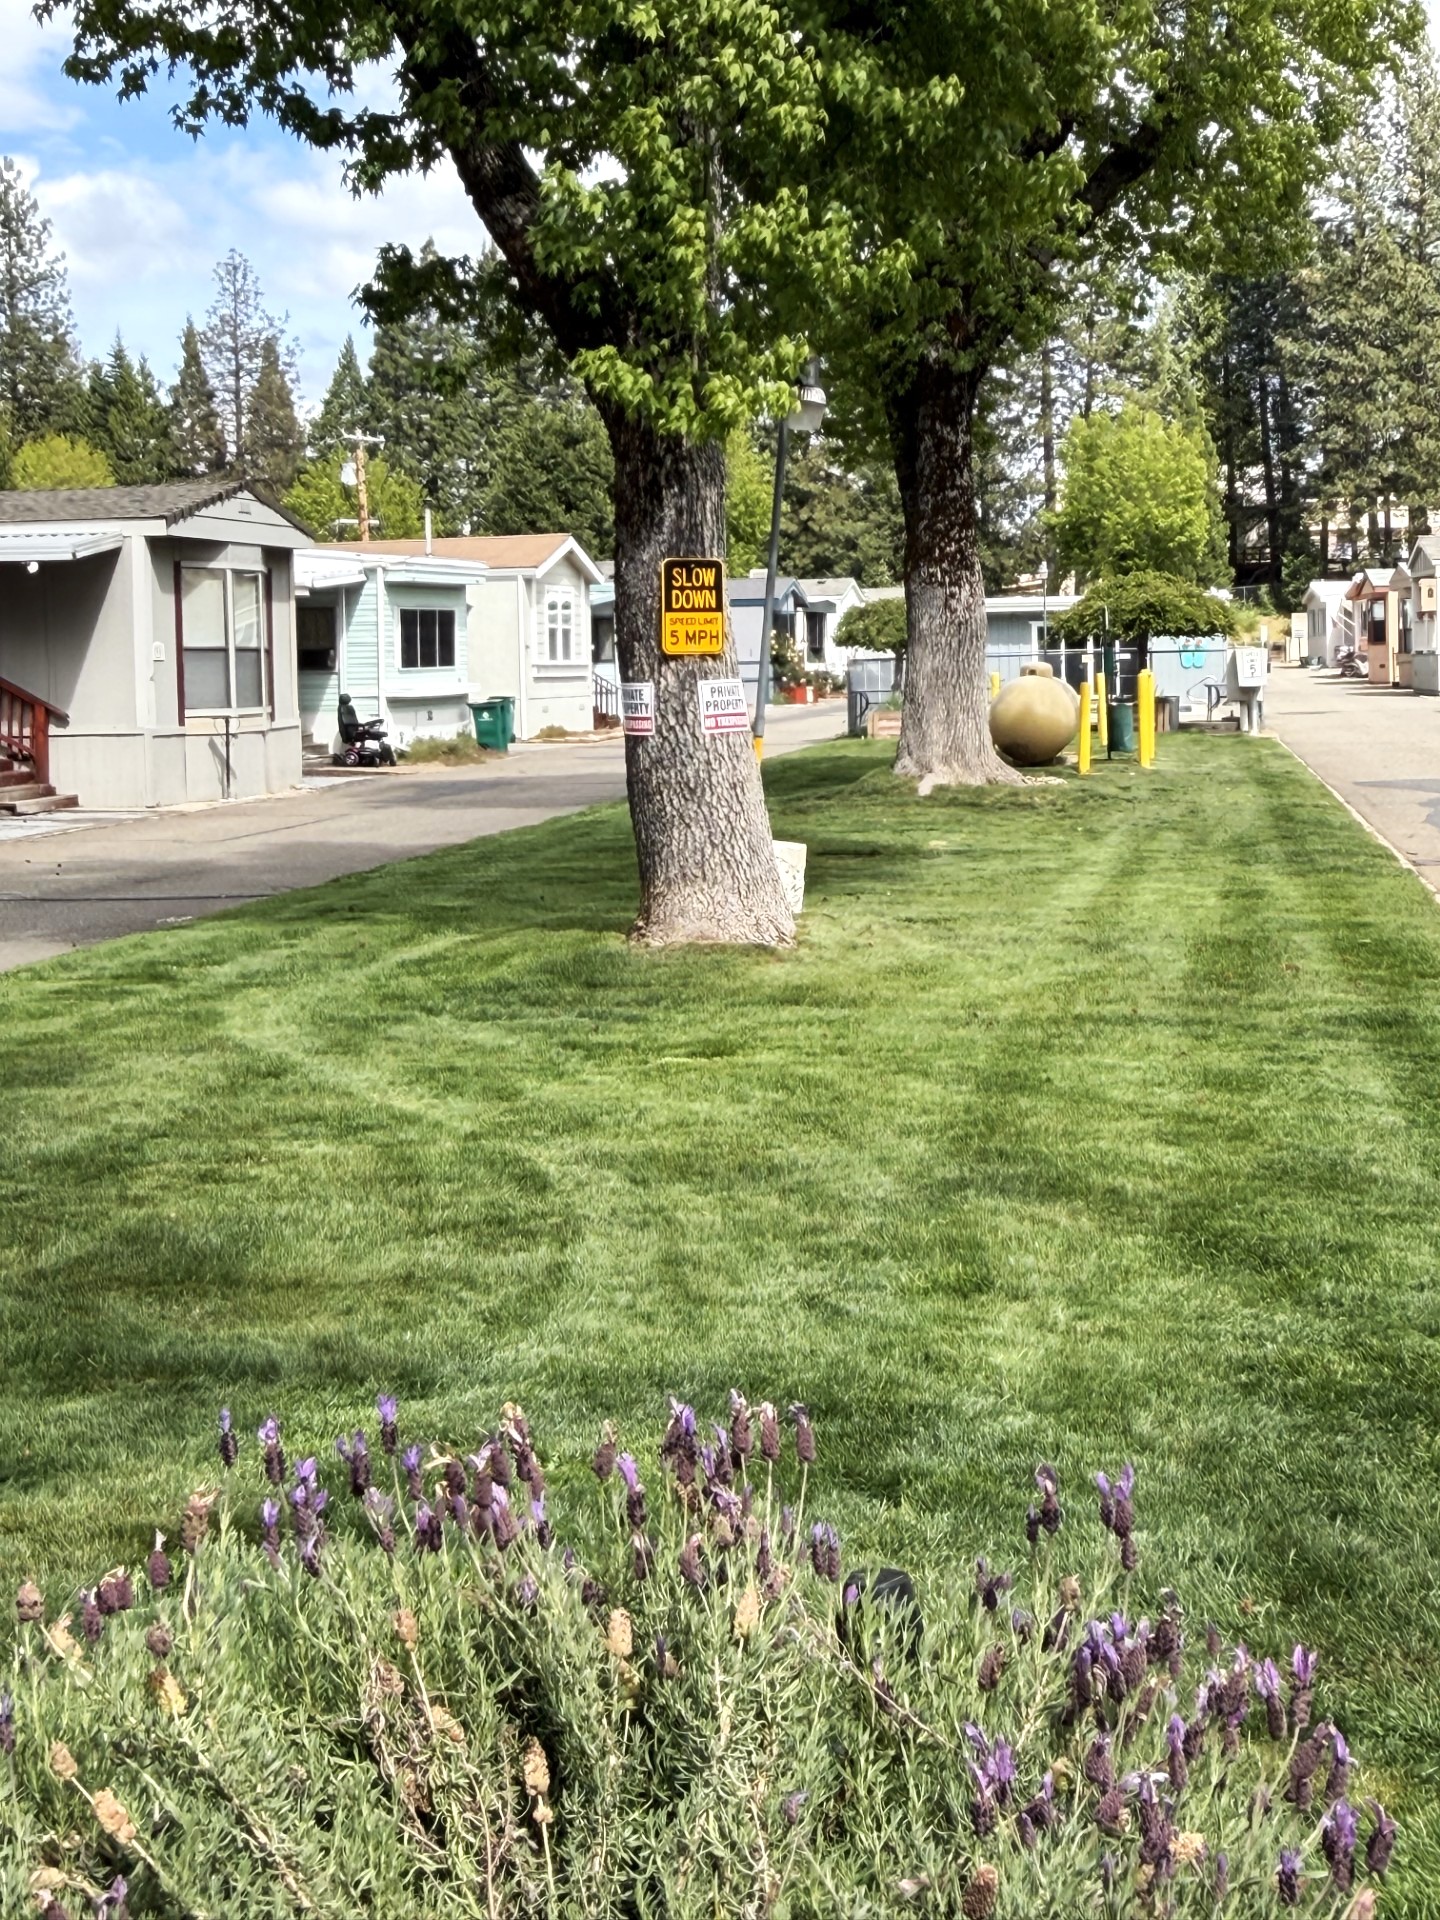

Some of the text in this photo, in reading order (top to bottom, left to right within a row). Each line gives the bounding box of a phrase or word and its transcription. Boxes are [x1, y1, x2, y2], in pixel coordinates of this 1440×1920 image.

[671, 567, 716, 588] SLOW
[671, 589, 717, 609] DOWN
[669, 616, 719, 626] SPEED LIMIT
[670, 629, 720, 646] 5 MPH
[710, 685, 741, 698] PRIVATE
[705, 698, 744, 712] PROPERTY
